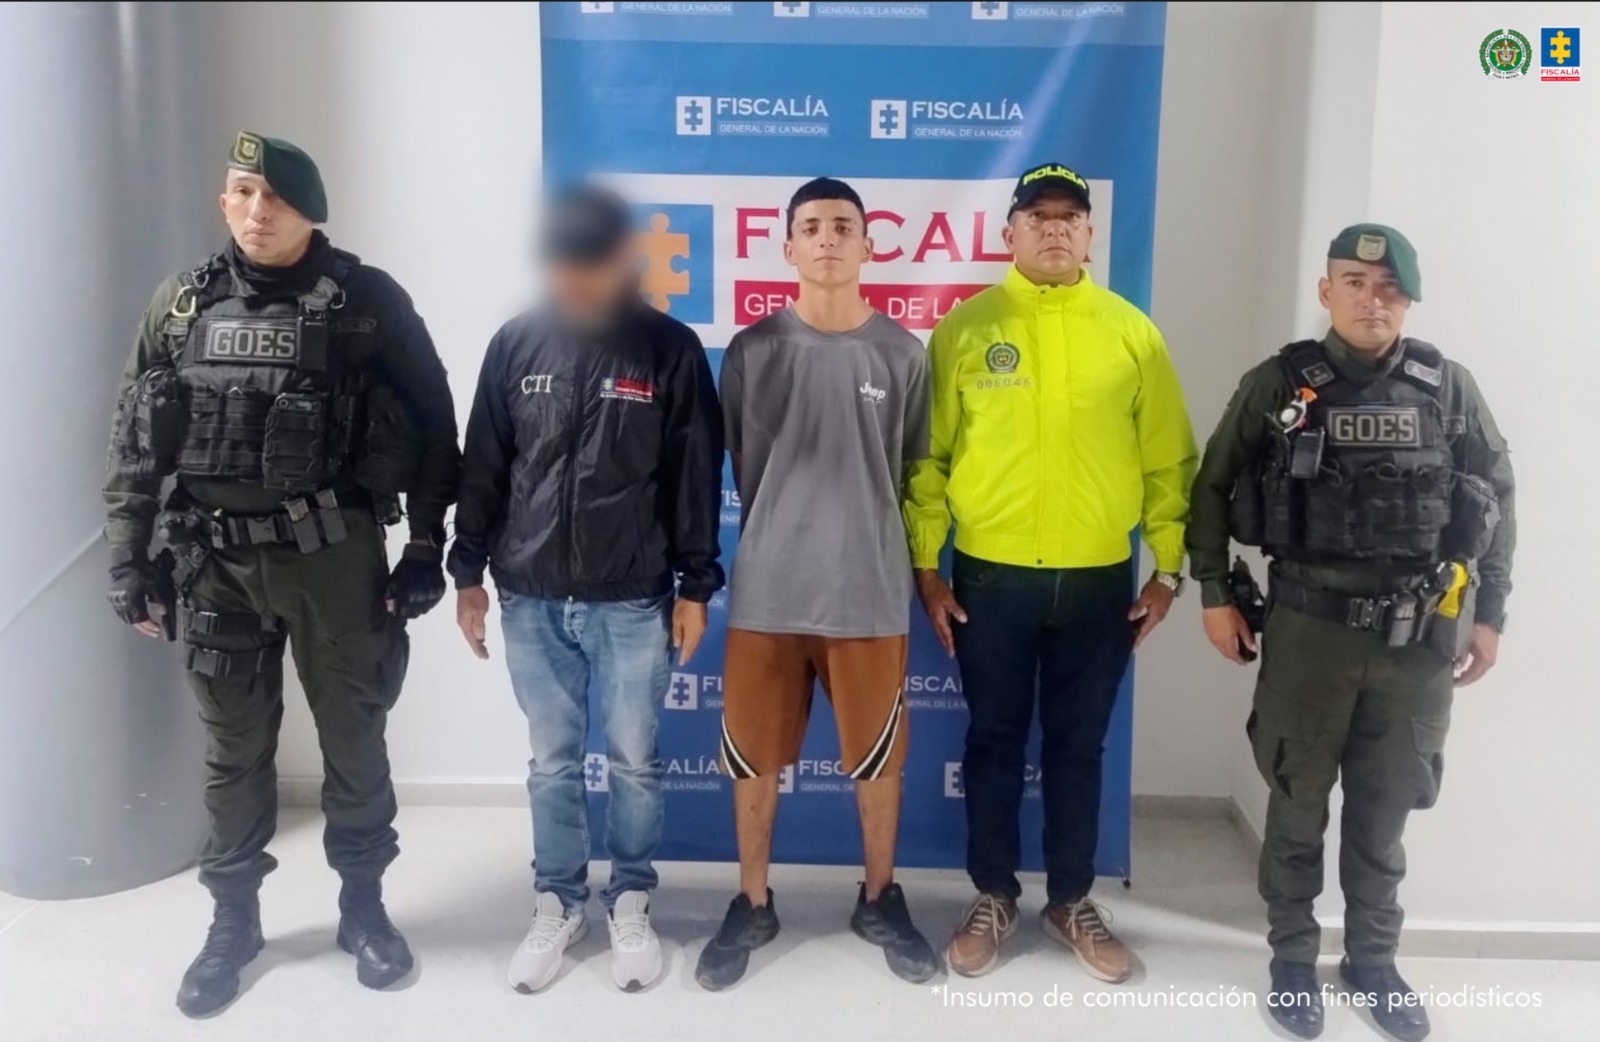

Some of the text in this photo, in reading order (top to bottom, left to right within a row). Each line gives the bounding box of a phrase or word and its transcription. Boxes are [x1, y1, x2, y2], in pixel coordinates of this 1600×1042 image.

[817, 5, 861, 15] GENERAL
[863, 6, 876, 15] DE
[878, 6, 890, 15] LA
[1015, 7, 1060, 18] GENERAL
[1061, 8, 1076, 18] DE
[1076, 8, 1088, 17] LA
[716, 95, 829, 117] FISCALÍA
[912, 98, 1025, 120] FISCALÍA
[719, 123, 827, 135] GENERAL DE LA NACIÓN
[914, 127, 1022, 138] GENERAL DE LA NACIÓN
[888, 297, 924, 319] DE
[213, 327, 296, 358] GOES
[521, 374, 553, 395] CTI
[1335, 414, 1414, 442] GOES
